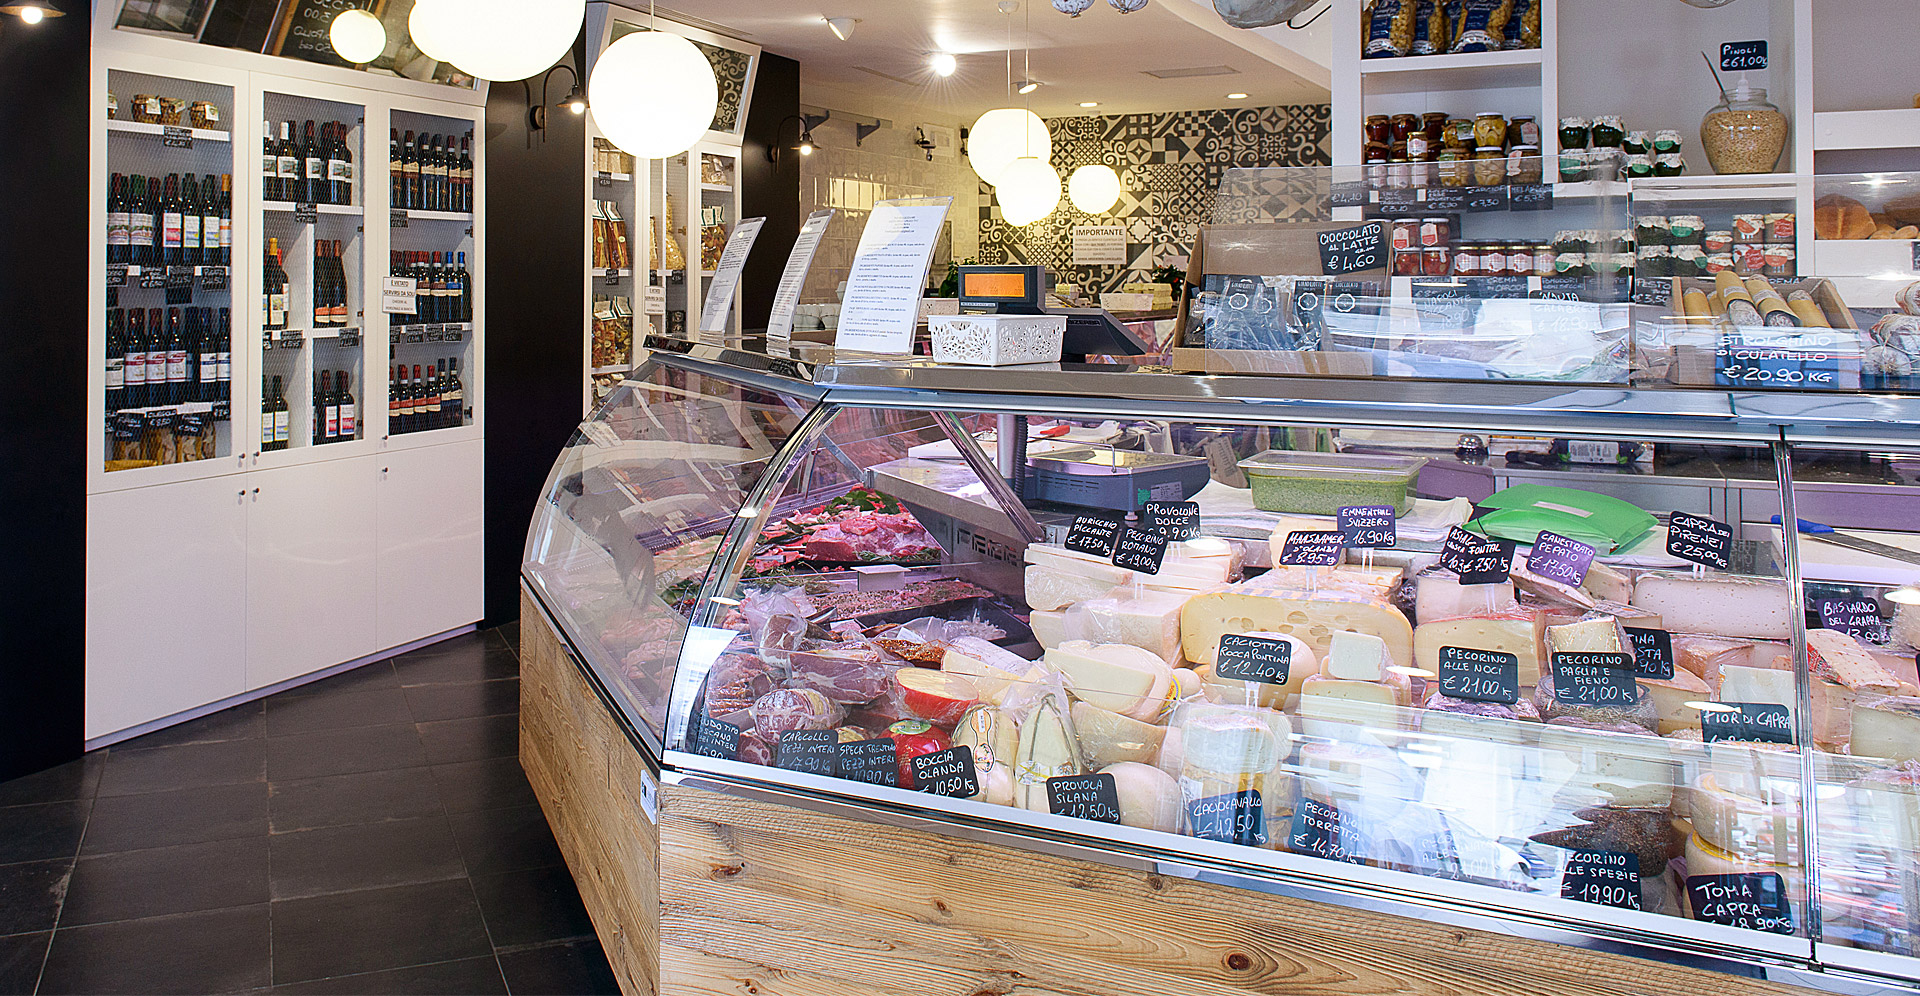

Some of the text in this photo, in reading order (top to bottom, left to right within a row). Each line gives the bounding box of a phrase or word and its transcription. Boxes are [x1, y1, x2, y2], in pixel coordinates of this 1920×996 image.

[1320, 224, 1381, 245] CIOCCOLATO
[1343, 236, 1379, 252] LATTE
[1328, 255, 1339, 269] €
[1735, 350, 1828, 362] CULATELLO
[1723, 365, 1741, 378] €
[1146, 503, 1199, 517] PROVOLONE
[1154, 517, 1189, 526] DOLCE
[1345, 517, 1390, 528] SVIZZERO
[1672, 516, 1717, 535] CAPRA
[1074, 524, 1112, 538] PICCANTE
[1670, 525, 1724, 550] PIRENEI
[1067, 534, 1077, 545] €
[1541, 534, 1594, 556] CANESTRATO
[1670, 541, 1682, 552] €
[1121, 541, 1157, 556] ROMANO
[1468, 543, 1501, 555] FONTAL
[1539, 543, 1579, 561] PEPATO
[1116, 553, 1126, 564] €
[1530, 555, 1543, 569] €
[1828, 615, 1881, 627] DEL GRAPPA
[1225, 637, 1285, 652] CACIOTTA
[1220, 646, 1289, 664] ROCCA PONTINA
[1447, 648, 1507, 663] PECORINO
[1557, 654, 1622, 665] PECORINO
[1443, 661, 1503, 675] ALLE NOCI
[1560, 665, 1611, 676] PAGLIA E
[1442, 675, 1456, 690] €
[1460, 676, 1499, 696] 21,00
[1574, 676, 1609, 685] FIENO
[1556, 687, 1574, 699] €
[1578, 686, 1618, 702] 21,00
[704, 719, 722, 730] UDO
[1743, 714, 1754, 724] DI
[1756, 712, 1791, 729] CAPRA
[703, 728, 731, 741] SCANO
[782, 732, 830, 742] CAPOCOLLO
[711, 738, 737, 752] INTERI
[807, 744, 835, 754] INTERI
[840, 744, 864, 757] SPECK
[869, 755, 895, 766] INTERI
[916, 749, 953, 769] BOCCIA
[919, 761, 964, 780] OLANDA
[1052, 779, 1103, 792] PROVOLA
[1056, 791, 1098, 803] SILANA
[1194, 796, 1262, 816] CACIOCAVALLO
[1305, 802, 1357, 827] PECORINO
[1217, 814, 1254, 839] 12,50
[1302, 814, 1359, 842] TORRETTA
[1294, 833, 1308, 847] €
[1311, 838, 1345, 858] 14,70
[1590, 867, 1638, 882] SPEZIE
[1579, 883, 1625, 905] 19,90
[1695, 882, 1752, 899] TOMA
[1702, 902, 1761, 917] CAPRA
